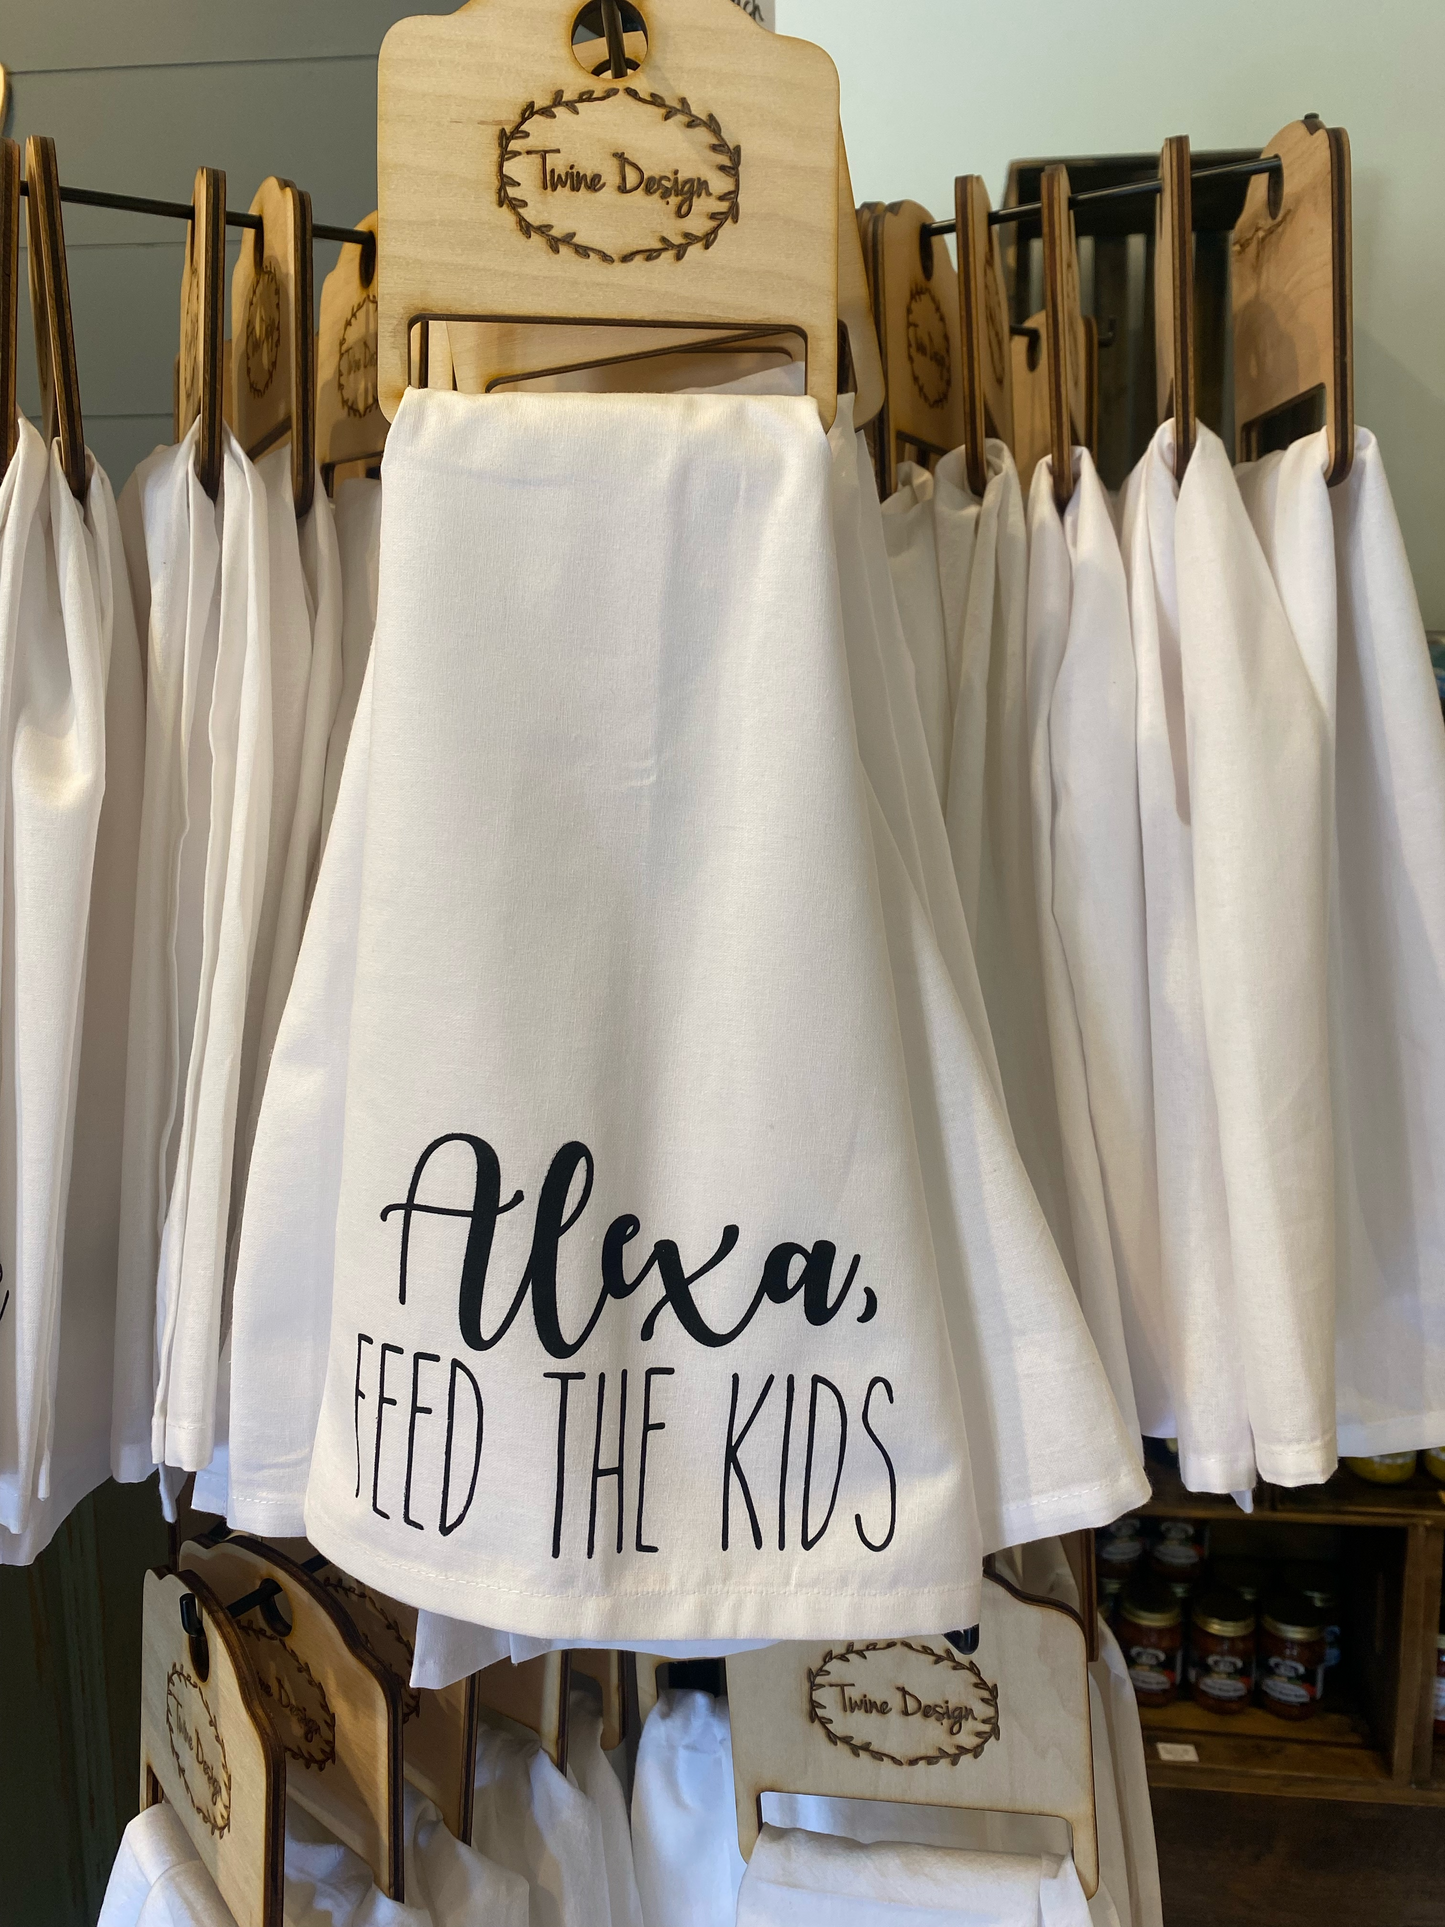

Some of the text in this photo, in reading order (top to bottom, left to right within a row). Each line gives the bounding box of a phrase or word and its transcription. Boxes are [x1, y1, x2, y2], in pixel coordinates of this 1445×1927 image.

[526, 149, 713, 219] Twine Design
[379, 1132, 878, 1360] Alexa,
[355, 1333, 897, 1560] FEED THE KIDS
[829, 1683, 977, 1735] Twine Design
